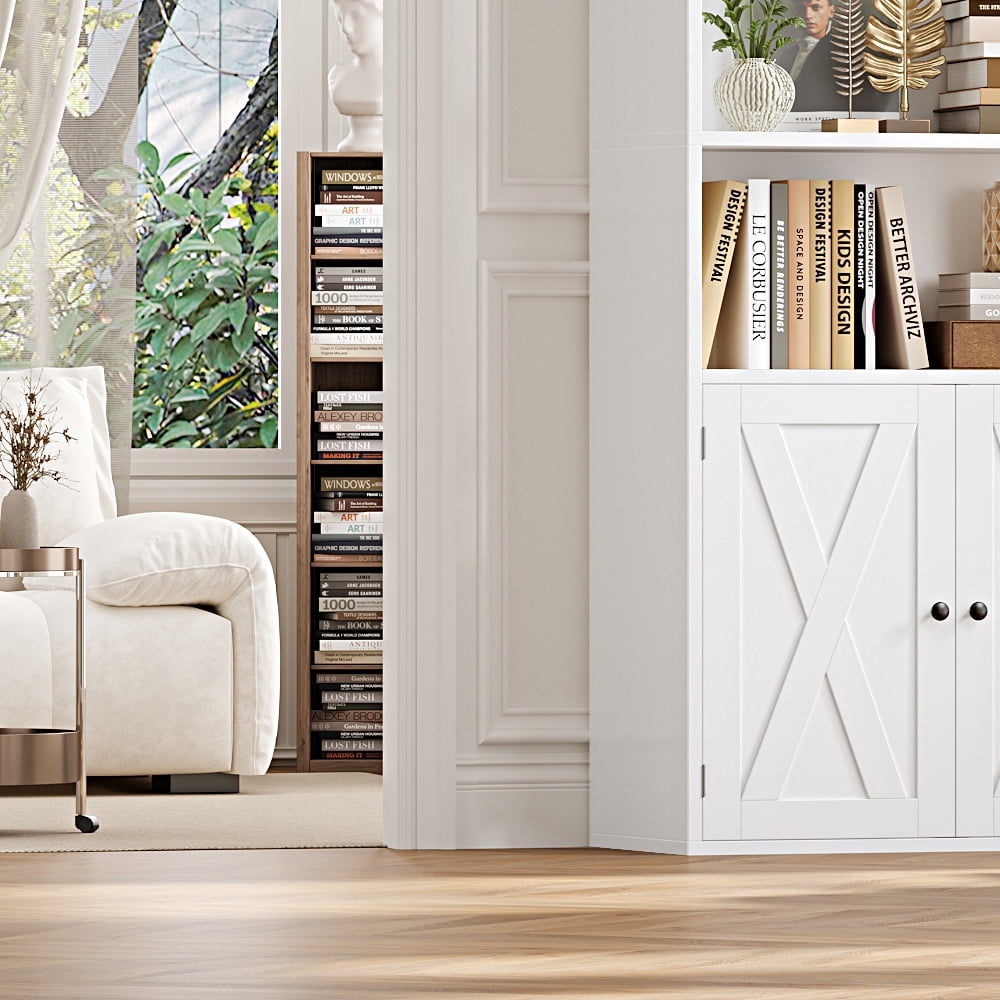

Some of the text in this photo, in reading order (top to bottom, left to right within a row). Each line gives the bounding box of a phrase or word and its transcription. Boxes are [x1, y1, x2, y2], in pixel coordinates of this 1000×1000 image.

[325, 172, 372, 182] WINDOWS
[342, 206, 360, 214] ART
[348, 217, 366, 225] ART
[711, 189, 742, 282] DESIGN FESTIVAL
[815, 188, 826, 283] DESIGN FESTIVAL
[857, 191, 865, 289] OPEN DESIGN NIGHT
[752, 215, 767, 341] LE CORBUSIER
[776, 220, 785, 333] BE BETTER RENDERINGS
[796, 228, 804, 321] SPACE AND DESIGN
[890, 217, 921, 340] BETTER ARCHVIZ
[837, 229, 851, 335] KIDS DESIGN
[315, 293, 348, 304] 1000
[985, 309, 1000, 317] GO
[342, 315, 367, 323] BOOK
[320, 393, 371, 402] LOST FISH
[318, 412, 358, 421] ALEXEY
[320, 441, 371, 450] LOST FISH
[324, 479, 371, 489] WINDOWS
[340, 513, 359, 521] ART
[347, 524, 366, 532] ART
[322, 599, 356, 610] 1000
[324, 693, 375, 701] LOST FISH
[312, 712, 351, 721] ALEXEY
[324, 741, 375, 750] LOST FISH
